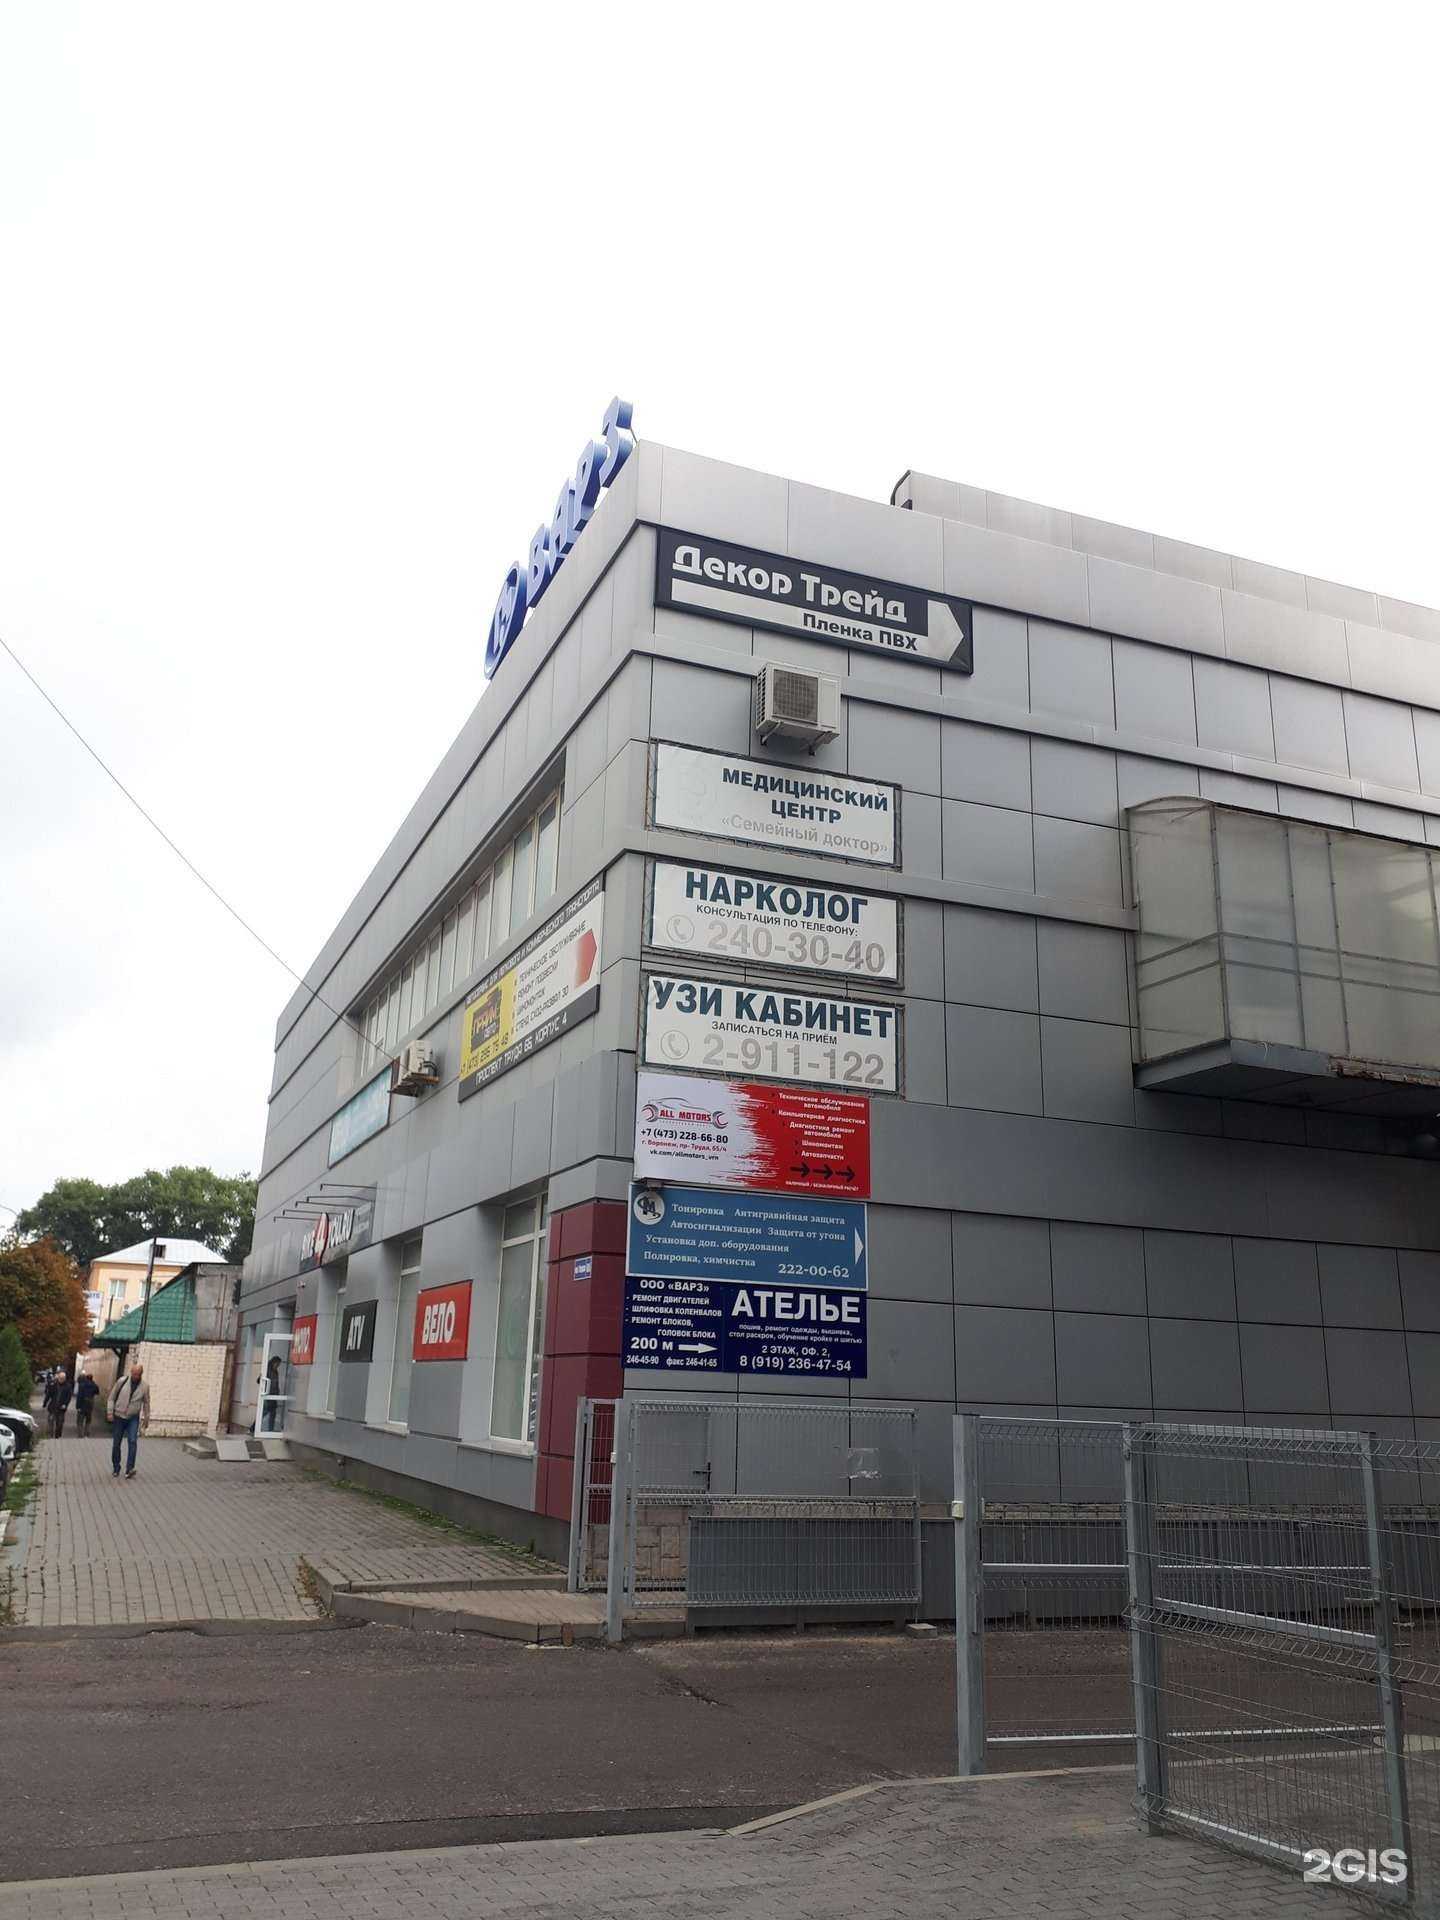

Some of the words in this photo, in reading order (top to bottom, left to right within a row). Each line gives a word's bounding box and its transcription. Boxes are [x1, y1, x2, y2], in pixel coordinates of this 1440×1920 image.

[672, 545, 792, 594] Декор
[801, 573, 906, 623] Трейд
[803, 612, 872, 641] Пленка
[880, 630, 917, 651] ПВХ
[723, 768, 888, 811] МЕДИЦИНСКИЙ
[771, 799, 841, 823] ЦЕНТР
[686, 871, 868, 924] НАРКОЛОГ
[696, 904, 780, 926] КОНСУЛЬТАЦИЯ
[783, 918, 798, 929] ПО
[801, 920, 858, 937] ТЕЛЕФОНУ:
[708, 921, 885, 973] 240-30-40
[652, 980, 721, 1017] УЗИ
[735, 991, 893, 1038] КАБИНЕТ
[711, 1020, 782, 1039] ЗАПИСАТЬСЯ
[785, 1030, 799, 1041] НА
[703, 1033, 884, 1085] 2-911-122
[660, 1109, 675, 1118] ALL
[678, 1111, 712, 1122] MOTORS
[641, 1129, 652, 1137] +7
[653, 1129, 678, 1141] (473)
[679, 1131, 728, 1144] 228-66-80
[801, 1150, 845, 1161] Автозапчасти
[672, 1203, 725, 1216] Тонировка
[735, 1208, 808, 1222] Антигравийная
[810, 1215, 845, 1226] защита
[670, 1220, 762, 1235] Автосигнализации
[767, 1227, 805, 1239] Защита
[806, 1230, 818, 1239] от
[819, 1232, 846, 1242] угона
[646, 1234, 697, 1247] Установка
[698, 1239, 720, 1250] доп.
[722, 1240, 789, 1253] оборудования
[644, 1251, 701, 1264] Полировка,
[703, 1254, 756, 1267] химчистка
[778, 1263, 850, 1278] 222-00-62
[640, 1279, 665, 1289] ООО
[668, 1281, 710, 1292] «ВАРЗ»
[632, 1294, 662, 1303] РЕМОНТ
[663, 1295, 710, 1305] ДВИГАТЕЛЕЙ
[731, 1289, 860, 1323] АТЕЛЬЕ
[632, 1306, 673, 1314] ШЛИФОВКА
[674, 1308, 722, 1317] КОЛЕНВАЛОВ
[422, 1300, 456, 1344] ВЕЛО
[631, 1316, 662, 1325] РЕМОНТ
[662, 1318, 694, 1327] БЛОКОВ,
[630, 1336, 658, 1349] 200
[657, 1329, 691, 1337] ГОЛОВОК
[692, 1330, 716, 1339] БЛОКА
[626, 1355, 659, 1365] 246-45-90
[666, 1356, 685, 1366] факс
[761, 1345, 768, 1354] 2
[770, 1345, 799, 1357] ЭТАЖ,
[801, 1347, 820, 1356] ОФ.
[822, 1348, 830, 1358] 2,
[740, 1355, 747, 1367] 8
[751, 1356, 784, 1369] (919)
[788, 1357, 852, 1372] 236-47-54
